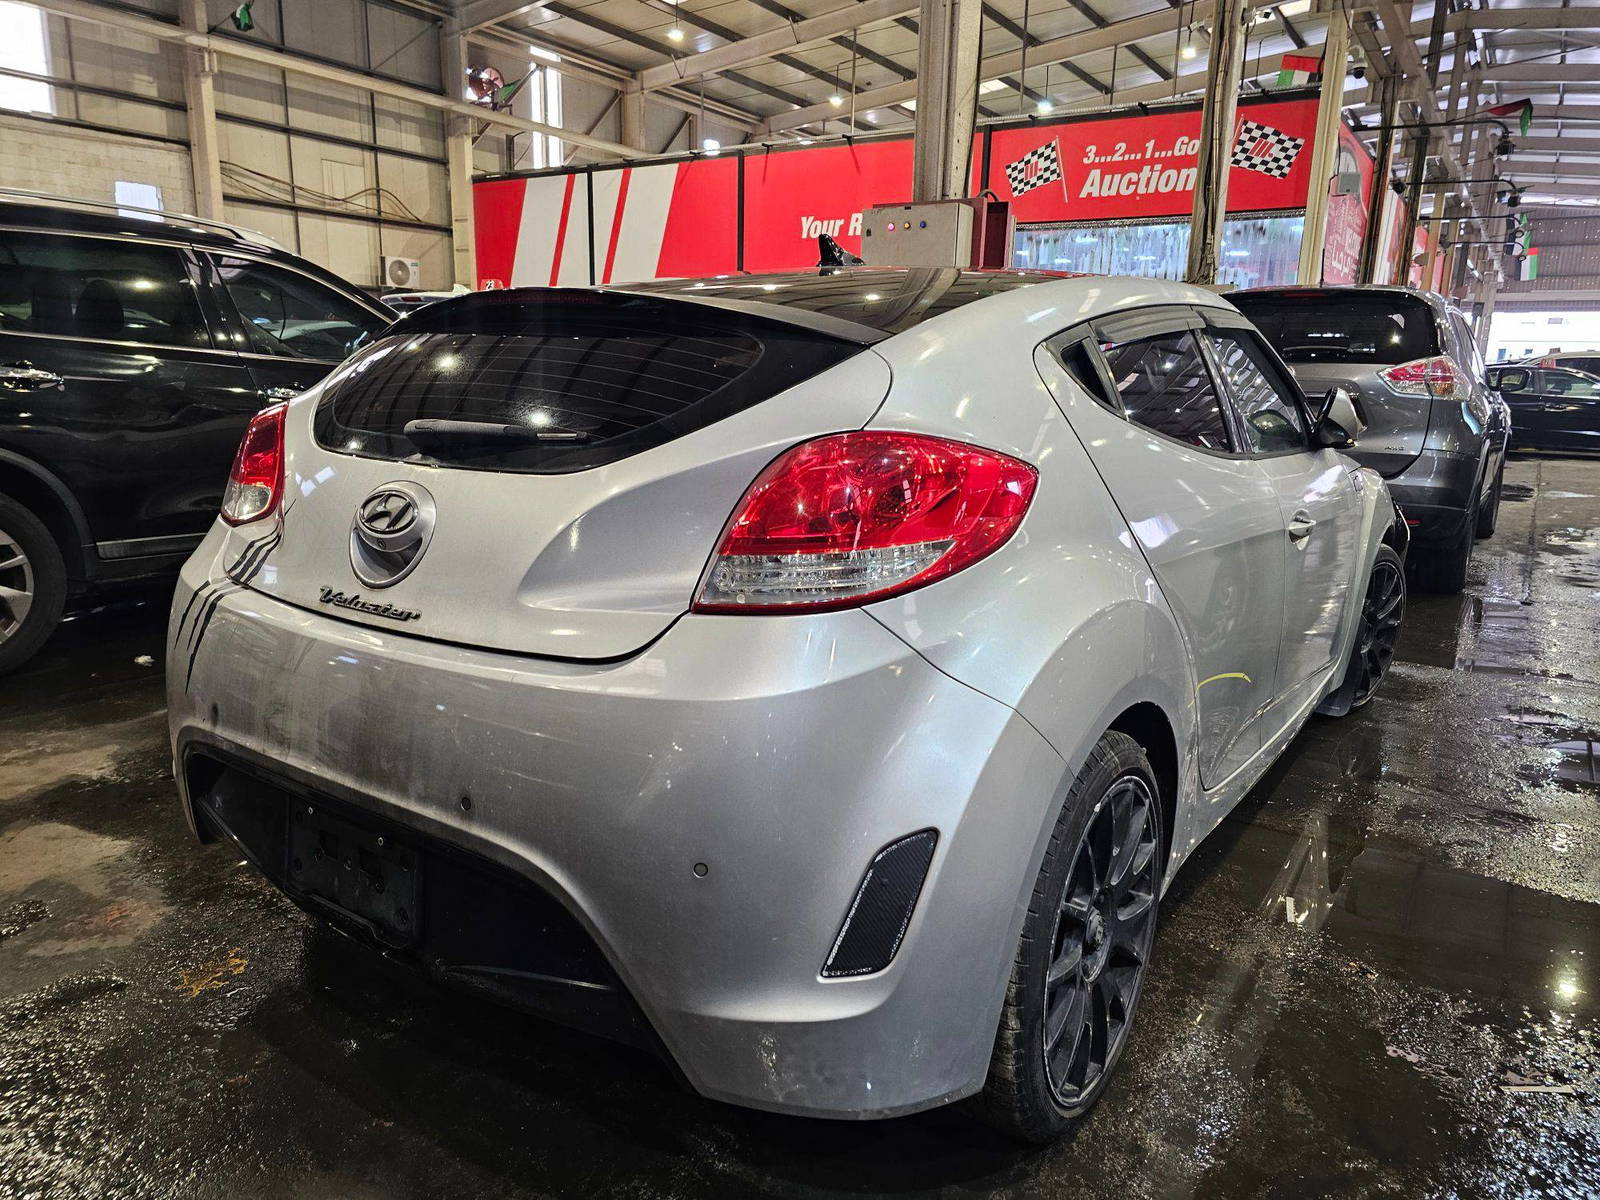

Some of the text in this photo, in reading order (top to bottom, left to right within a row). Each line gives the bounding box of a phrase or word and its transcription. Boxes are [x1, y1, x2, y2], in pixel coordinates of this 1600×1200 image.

[1078, 163, 1198, 198] Auction
[800, 215, 845, 239] Your
[319, 585, 422, 621] Veloster
